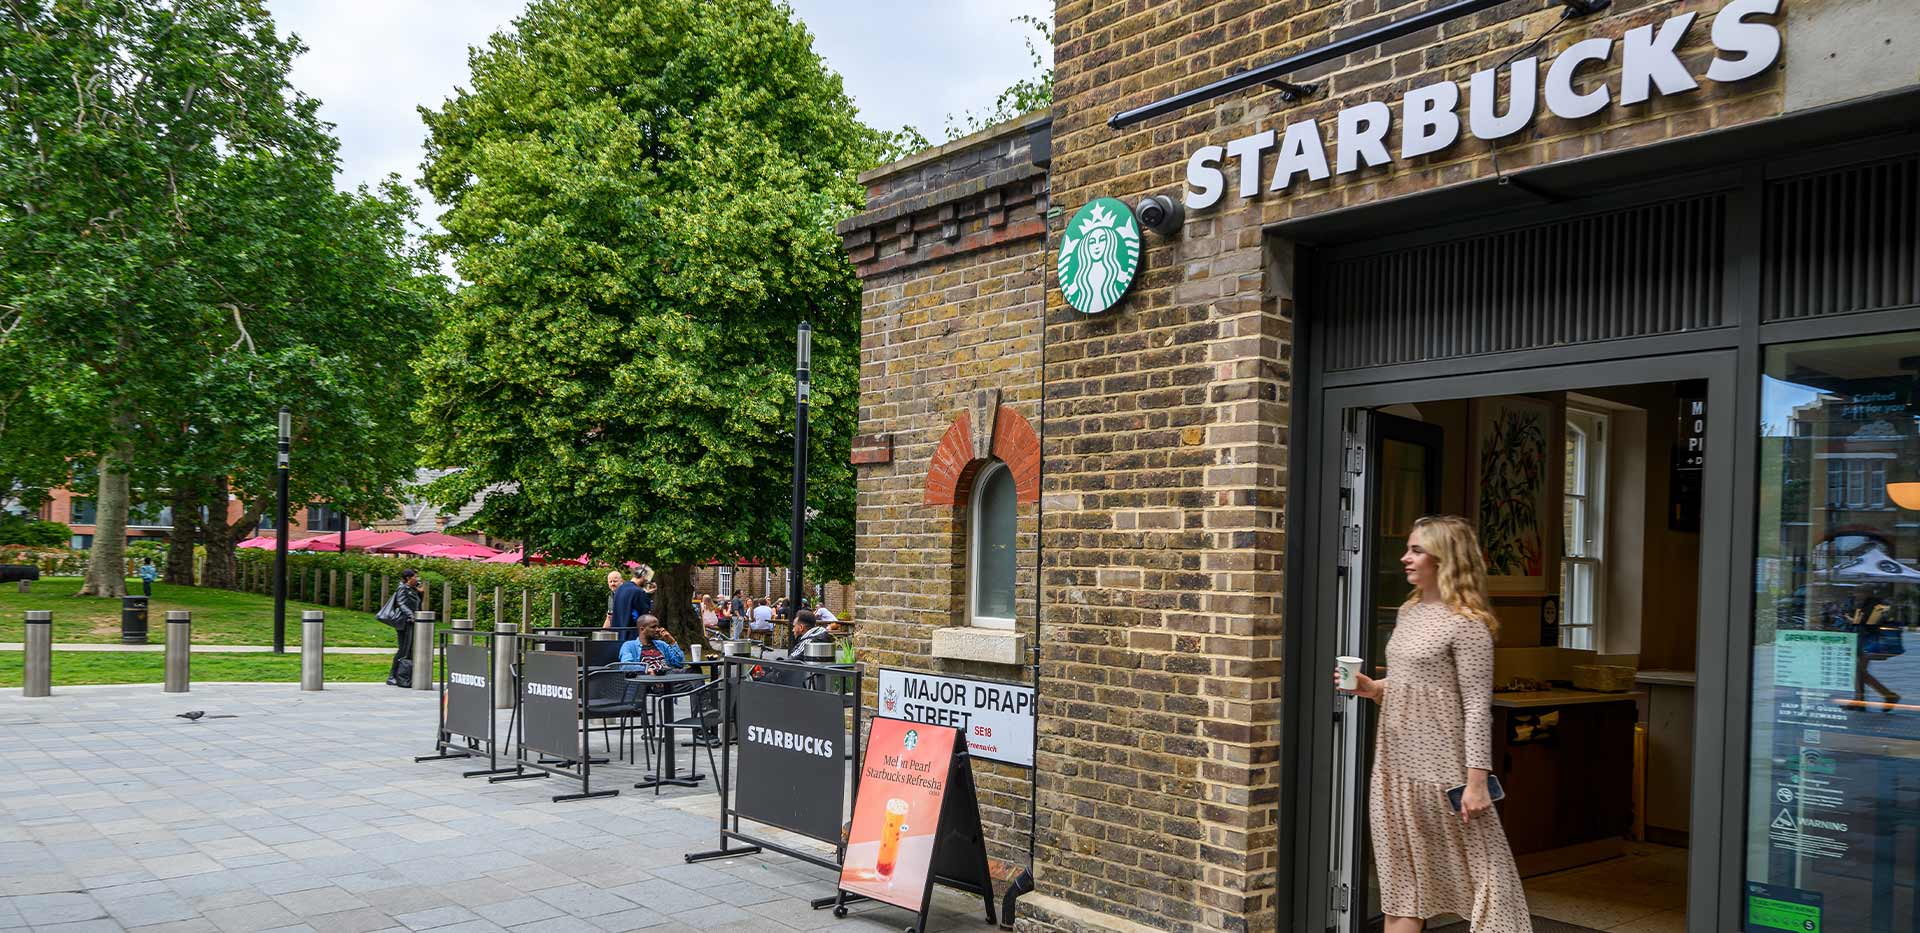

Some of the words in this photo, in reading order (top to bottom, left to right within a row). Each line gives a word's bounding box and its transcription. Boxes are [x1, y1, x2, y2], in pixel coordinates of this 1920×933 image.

[1185, 0, 1783, 210] STARBUCKS
[451, 672, 486, 688] STARBUCKS
[528, 682, 573, 700] STARBUCKS
[904, 677, 966, 706] MAJOR
[904, 703, 972, 734] STREET
[974, 725, 992, 738] SE18
[747, 725, 833, 758] STARBUCKS
[909, 759, 931, 773] Pearl
[866, 767, 906, 785] Starbucks
[1797, 816, 1849, 833] WARNING
